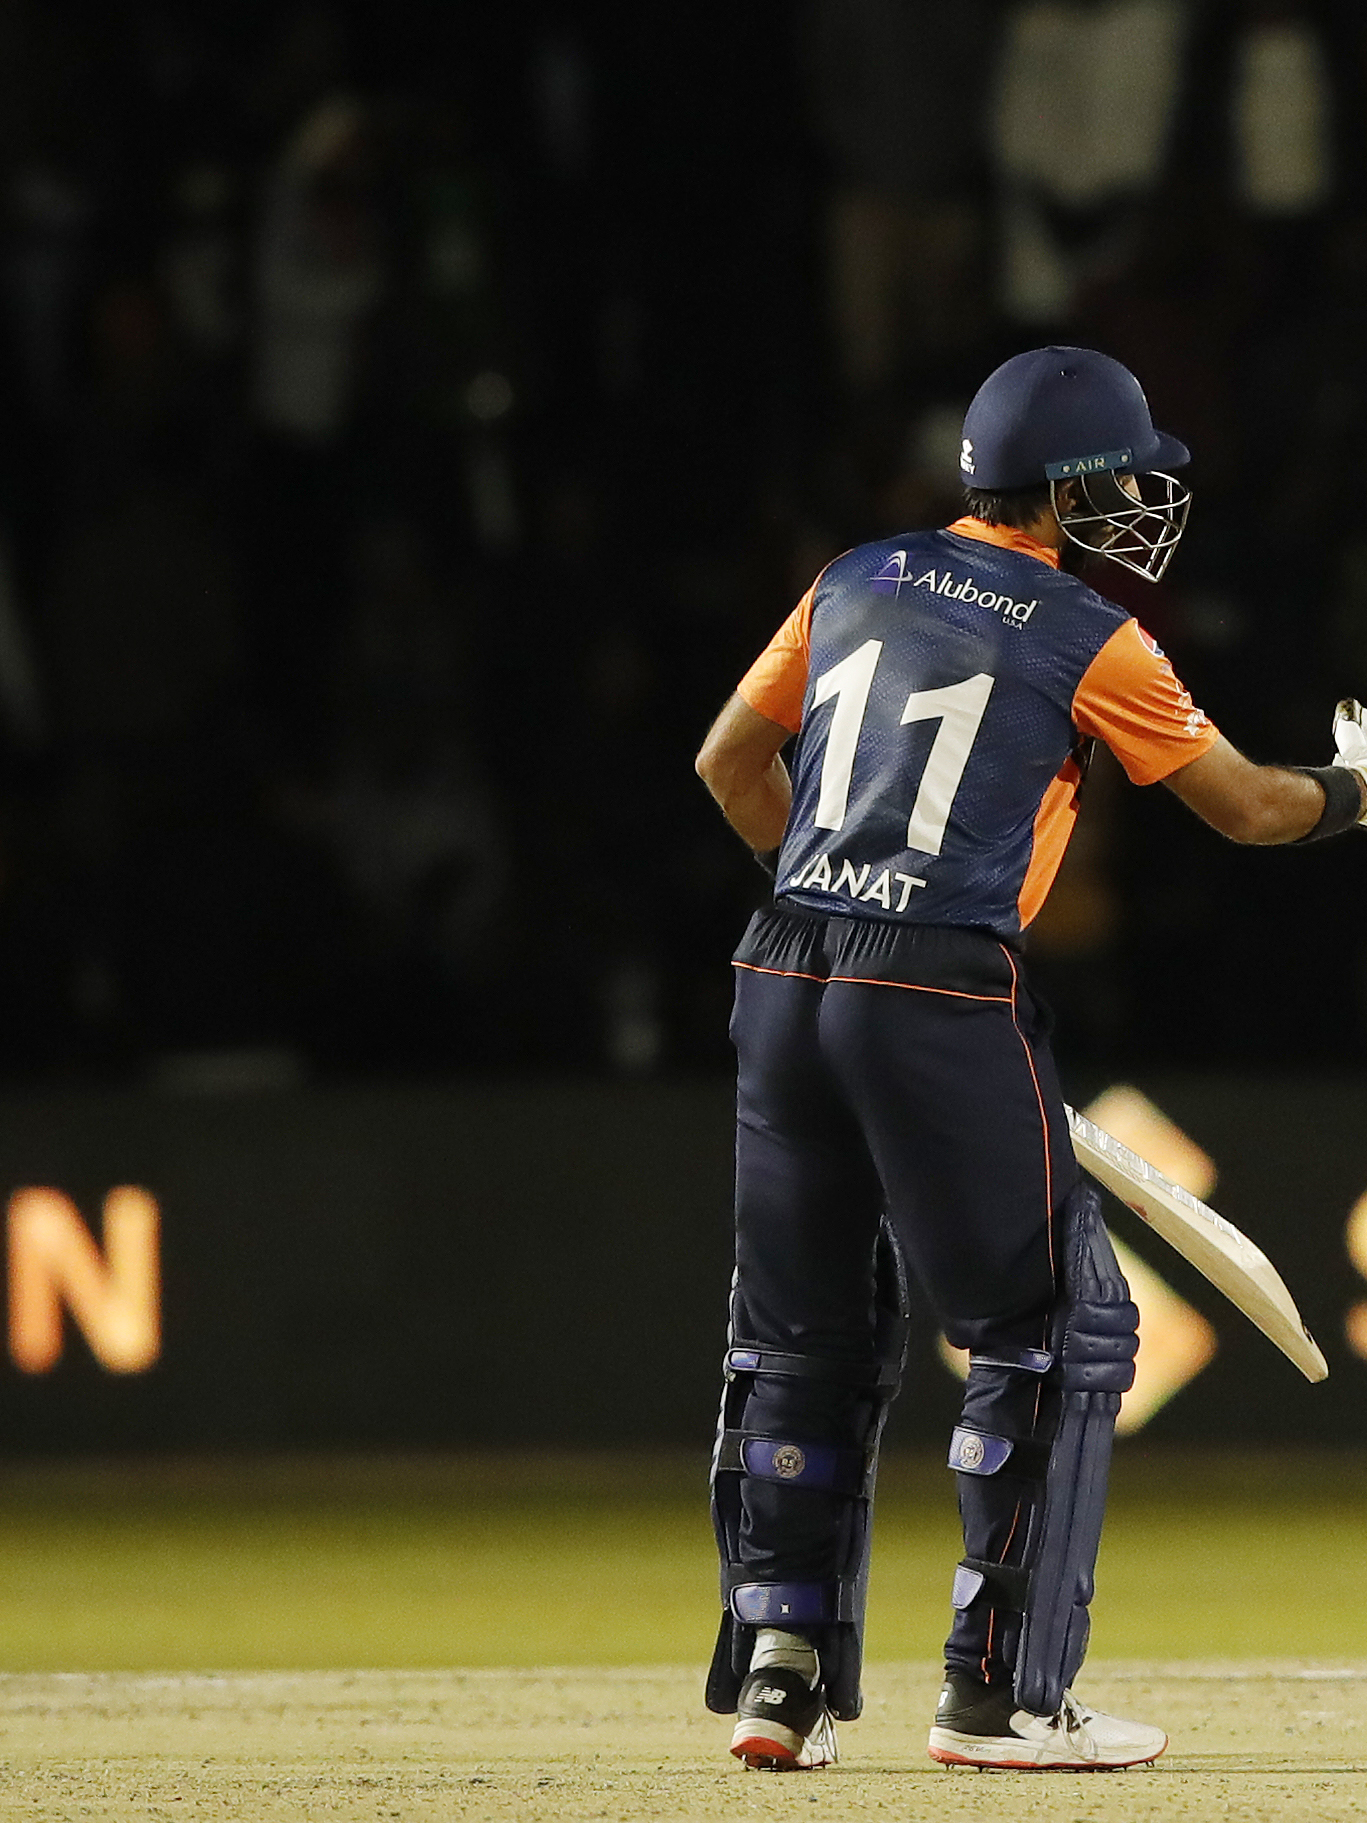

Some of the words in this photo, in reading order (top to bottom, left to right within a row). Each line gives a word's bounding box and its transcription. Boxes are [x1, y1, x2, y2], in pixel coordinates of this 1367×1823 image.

[1075, 457, 1106, 473] AIR
[913, 568, 1038, 623] Alubond
[810, 638, 996, 857] 11
[789, 852, 928, 913] JANAT
